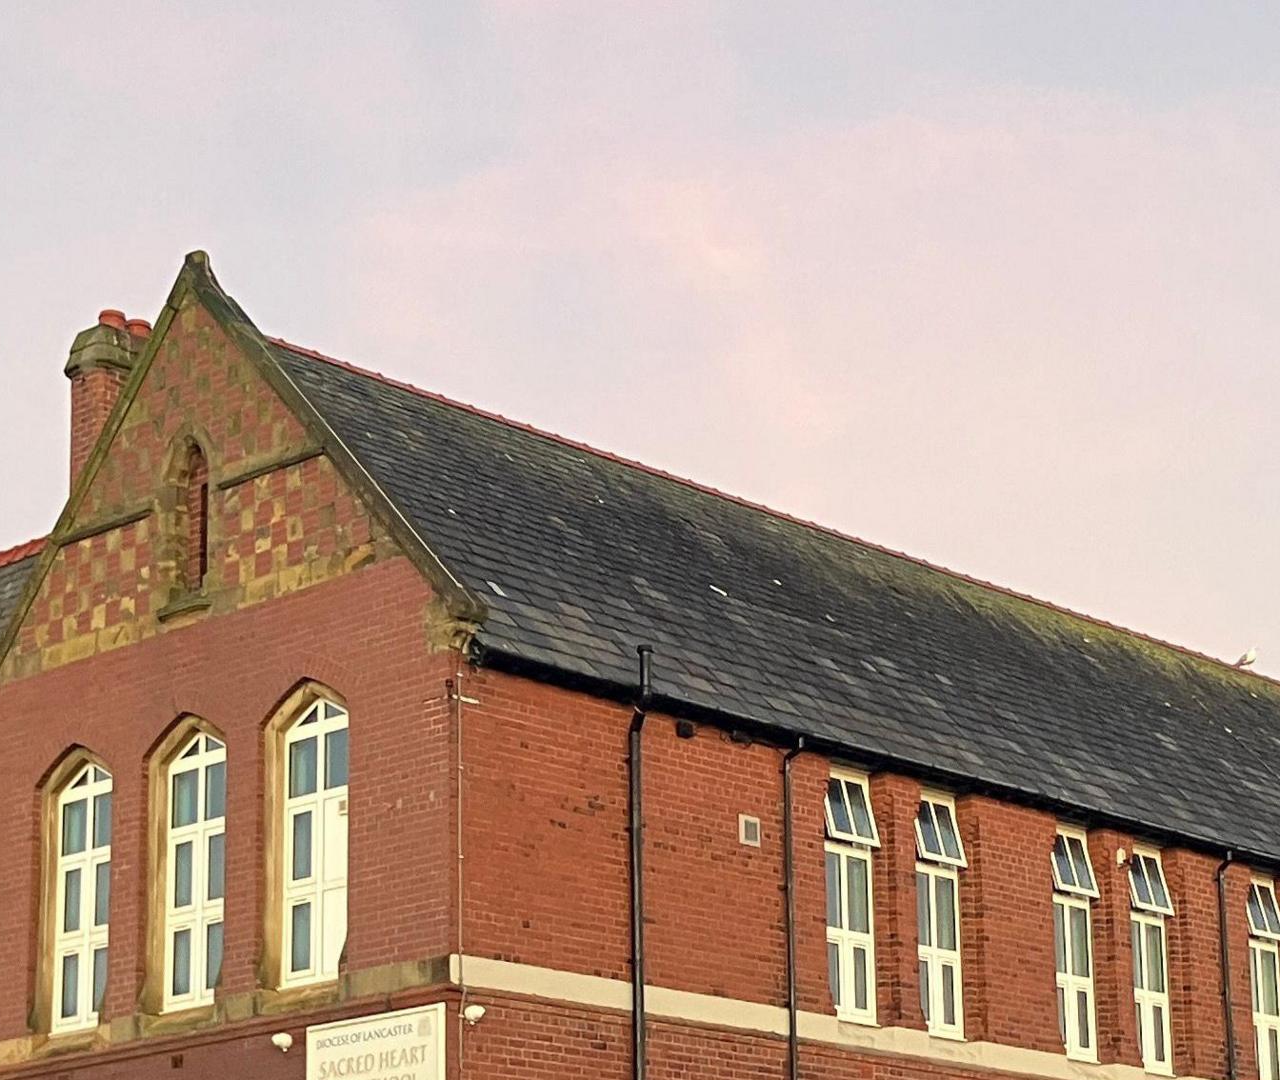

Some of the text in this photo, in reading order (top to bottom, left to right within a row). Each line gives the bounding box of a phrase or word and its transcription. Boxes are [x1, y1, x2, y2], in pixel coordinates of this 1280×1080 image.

[316, 1023, 414, 1050] DIOCESE OF LANCASTER
[317, 1044, 428, 1080] SACRED HEART
